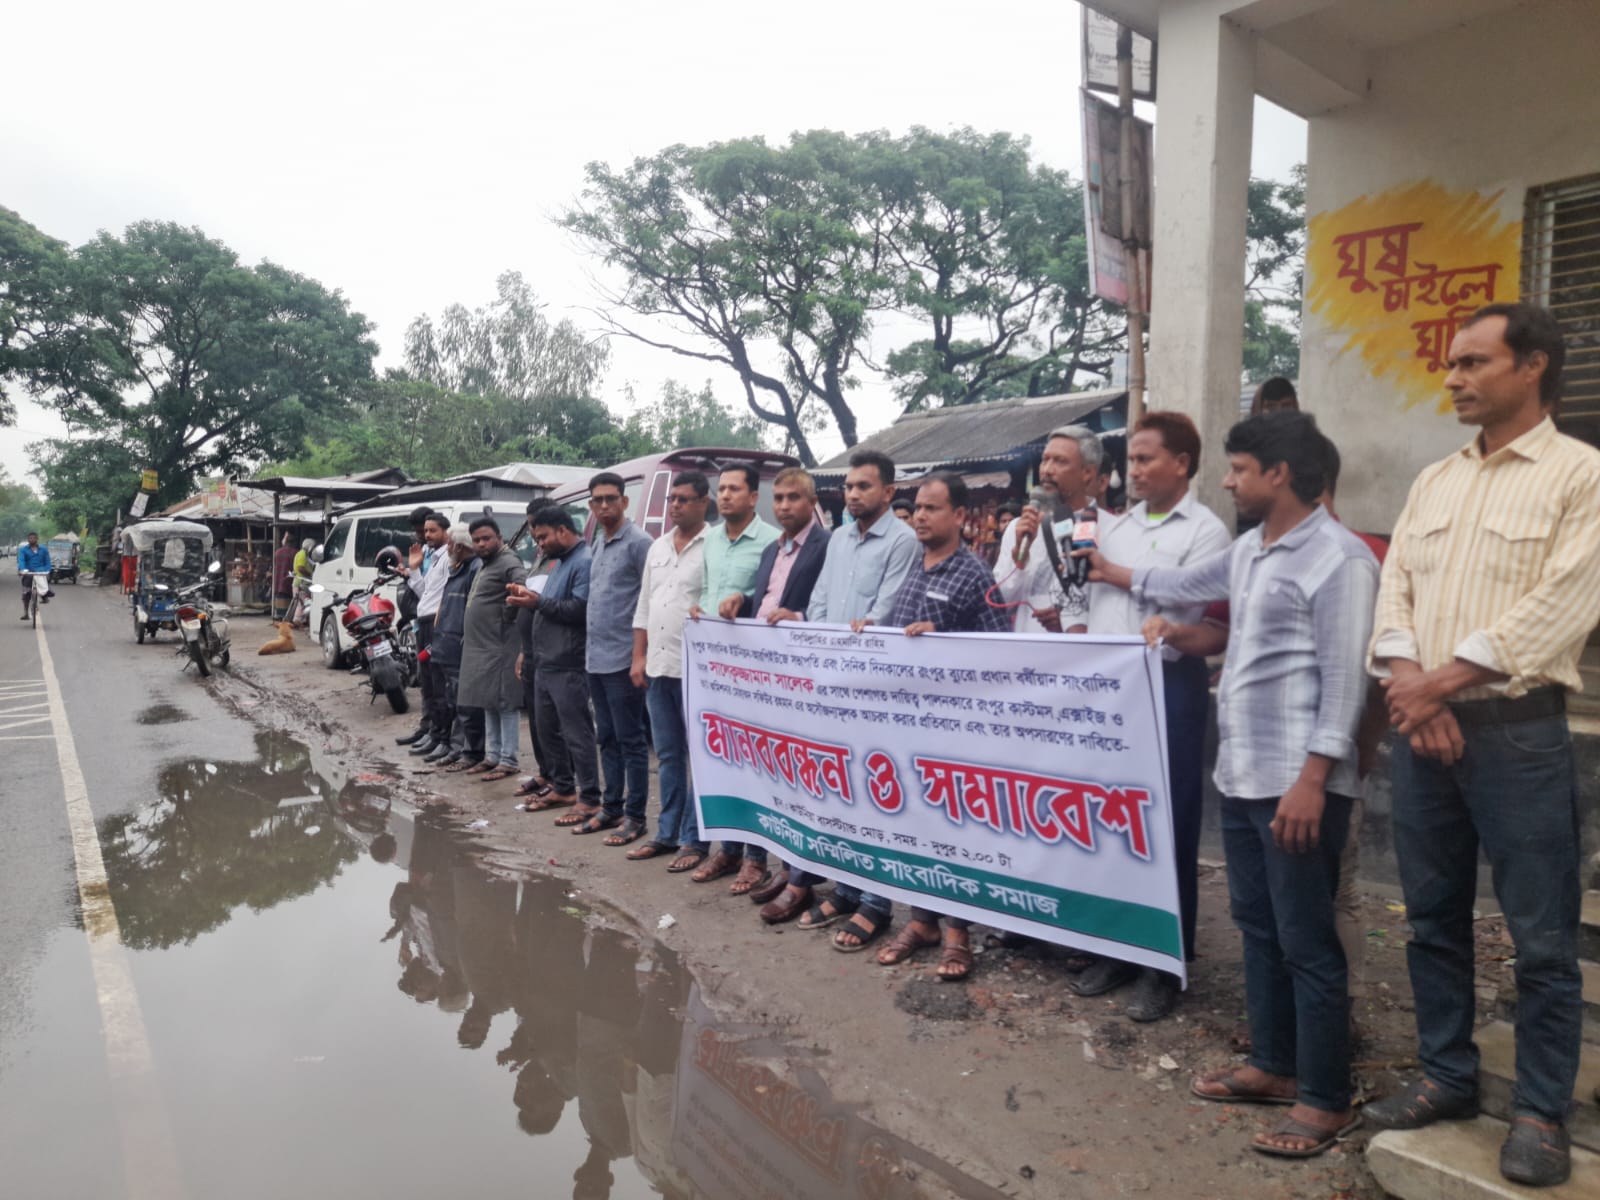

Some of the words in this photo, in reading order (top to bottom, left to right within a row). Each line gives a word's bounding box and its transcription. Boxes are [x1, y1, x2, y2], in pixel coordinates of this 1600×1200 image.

[1333, 222, 1424, 293] ঘুষ
[1380, 261, 1503, 313] চাইলে
[774, 673, 815, 693] সালেক
[816, 684, 828, 696] এর
[829, 685, 850, 699] সাথে
[852, 687, 888, 703] পেশাগত
[889, 687, 920, 710] দায়িত্ব
[976, 698, 1004, 716] রংপুর
[1007, 700, 1054, 720] কাস্টমস
[1111, 713, 1124, 727] ও
[823, 657, 838, 672] এবং
[840, 655, 866, 672] দৈনিক
[868, 657, 914, 678] দিনকালের
[917, 665, 945, 683] রংপুর
[947, 667, 977, 684] ব্যুরো
[980, 670, 1011, 685] প্রধান
[1014, 666, 1058, 688] বর্ষীয়ান
[1061, 672, 1121, 693] সাংবাদিক
[859, 708, 888, 724] আচরণ
[890, 712, 916, 727] করার
[919, 711, 961, 732] প্রতিবাদে
[965, 720, 988, 737] এবং
[988, 722, 1011, 738] তার
[1012, 725, 1074, 747] অপসারণের
[702, 712, 851, 802] মানববন্ধন
[864, 752, 903, 812] ও
[915, 757, 1150, 859] সমাবেশ
[755, 811, 805, 852] কাউনিয়া
[805, 835, 875, 872] সম্মিলিত
[878, 855, 980, 898] সাংবাদিক
[984, 881, 1060, 919] সমাজ
[892, 832, 917, 848] সময়
[931, 840, 957, 858] দুপুর
[961, 847, 994, 865] ২.০০
[998, 851, 1013, 870] টা
